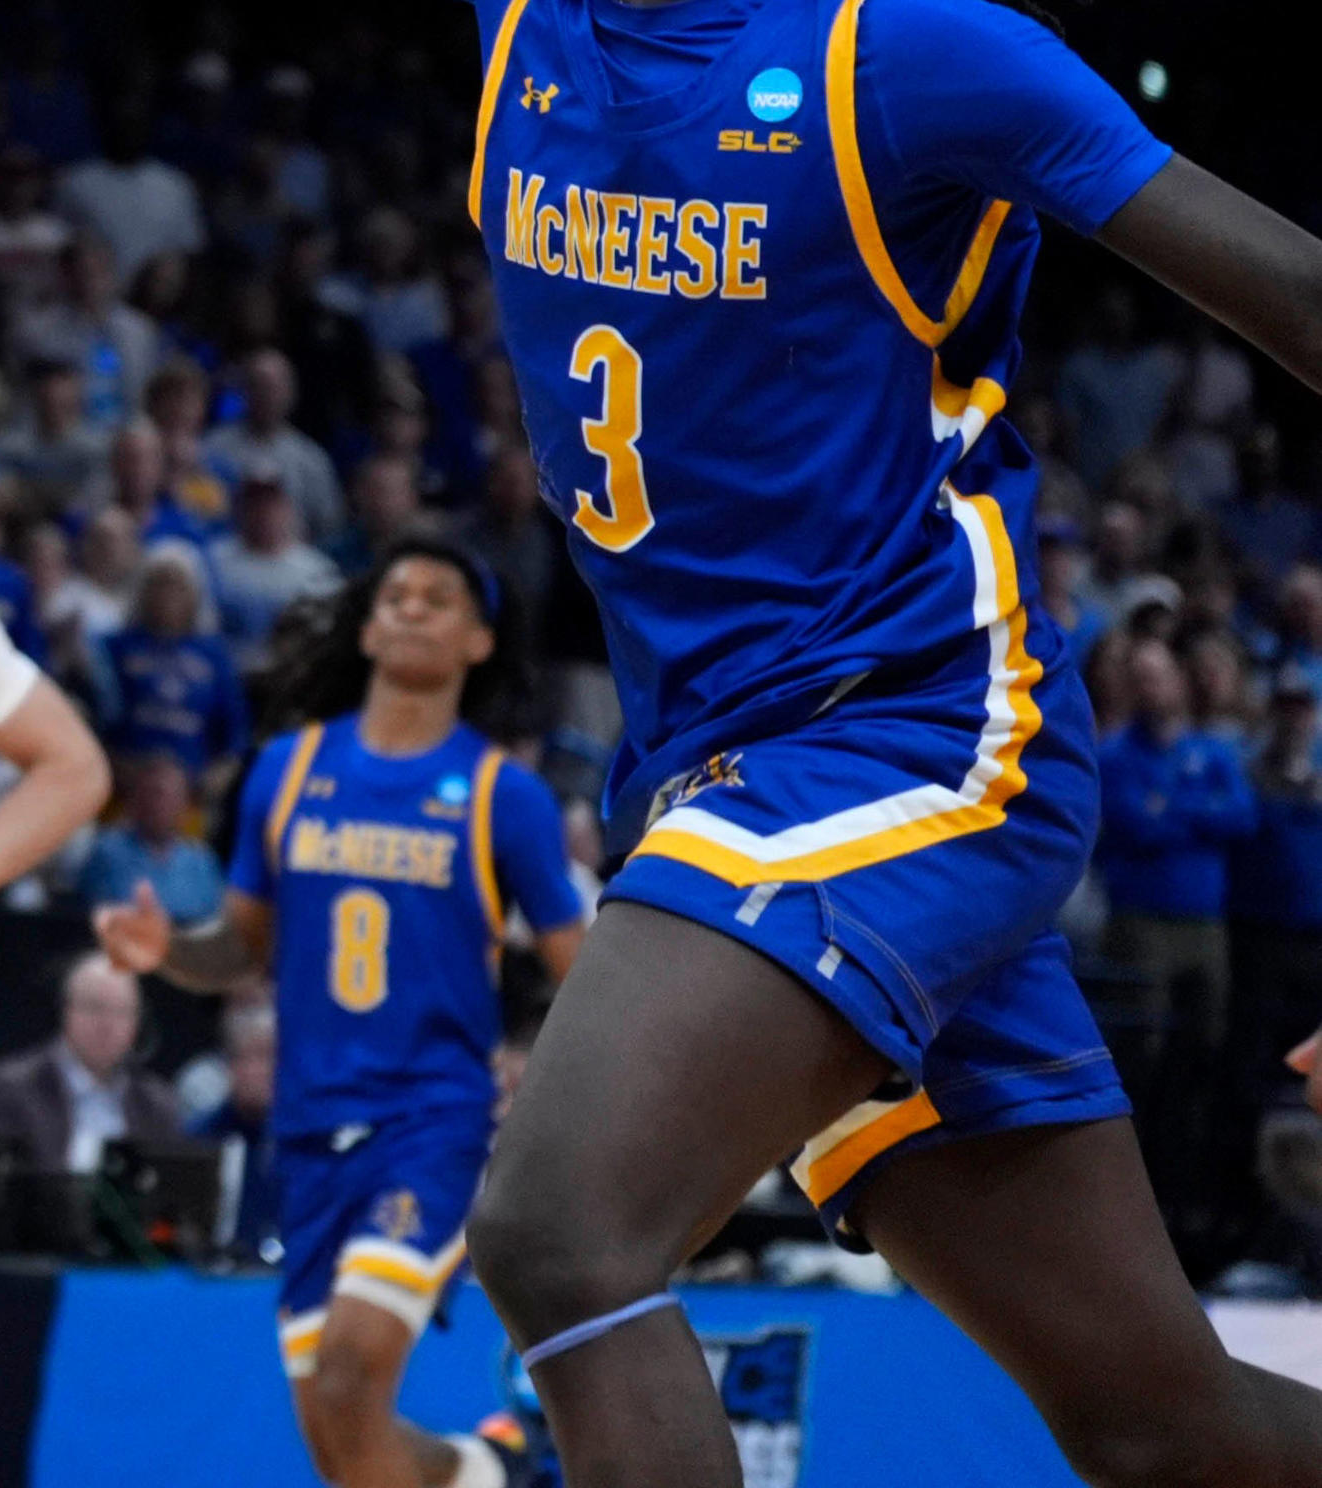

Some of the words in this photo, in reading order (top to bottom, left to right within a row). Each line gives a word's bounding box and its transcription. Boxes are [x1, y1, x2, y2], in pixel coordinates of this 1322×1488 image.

[717, 129, 795, 153] SLC
[753, 93, 799, 108] NCAA
[504, 167, 768, 300] McNEESE
[568, 324, 655, 553] 3
[329, 888, 390, 1015] 8
